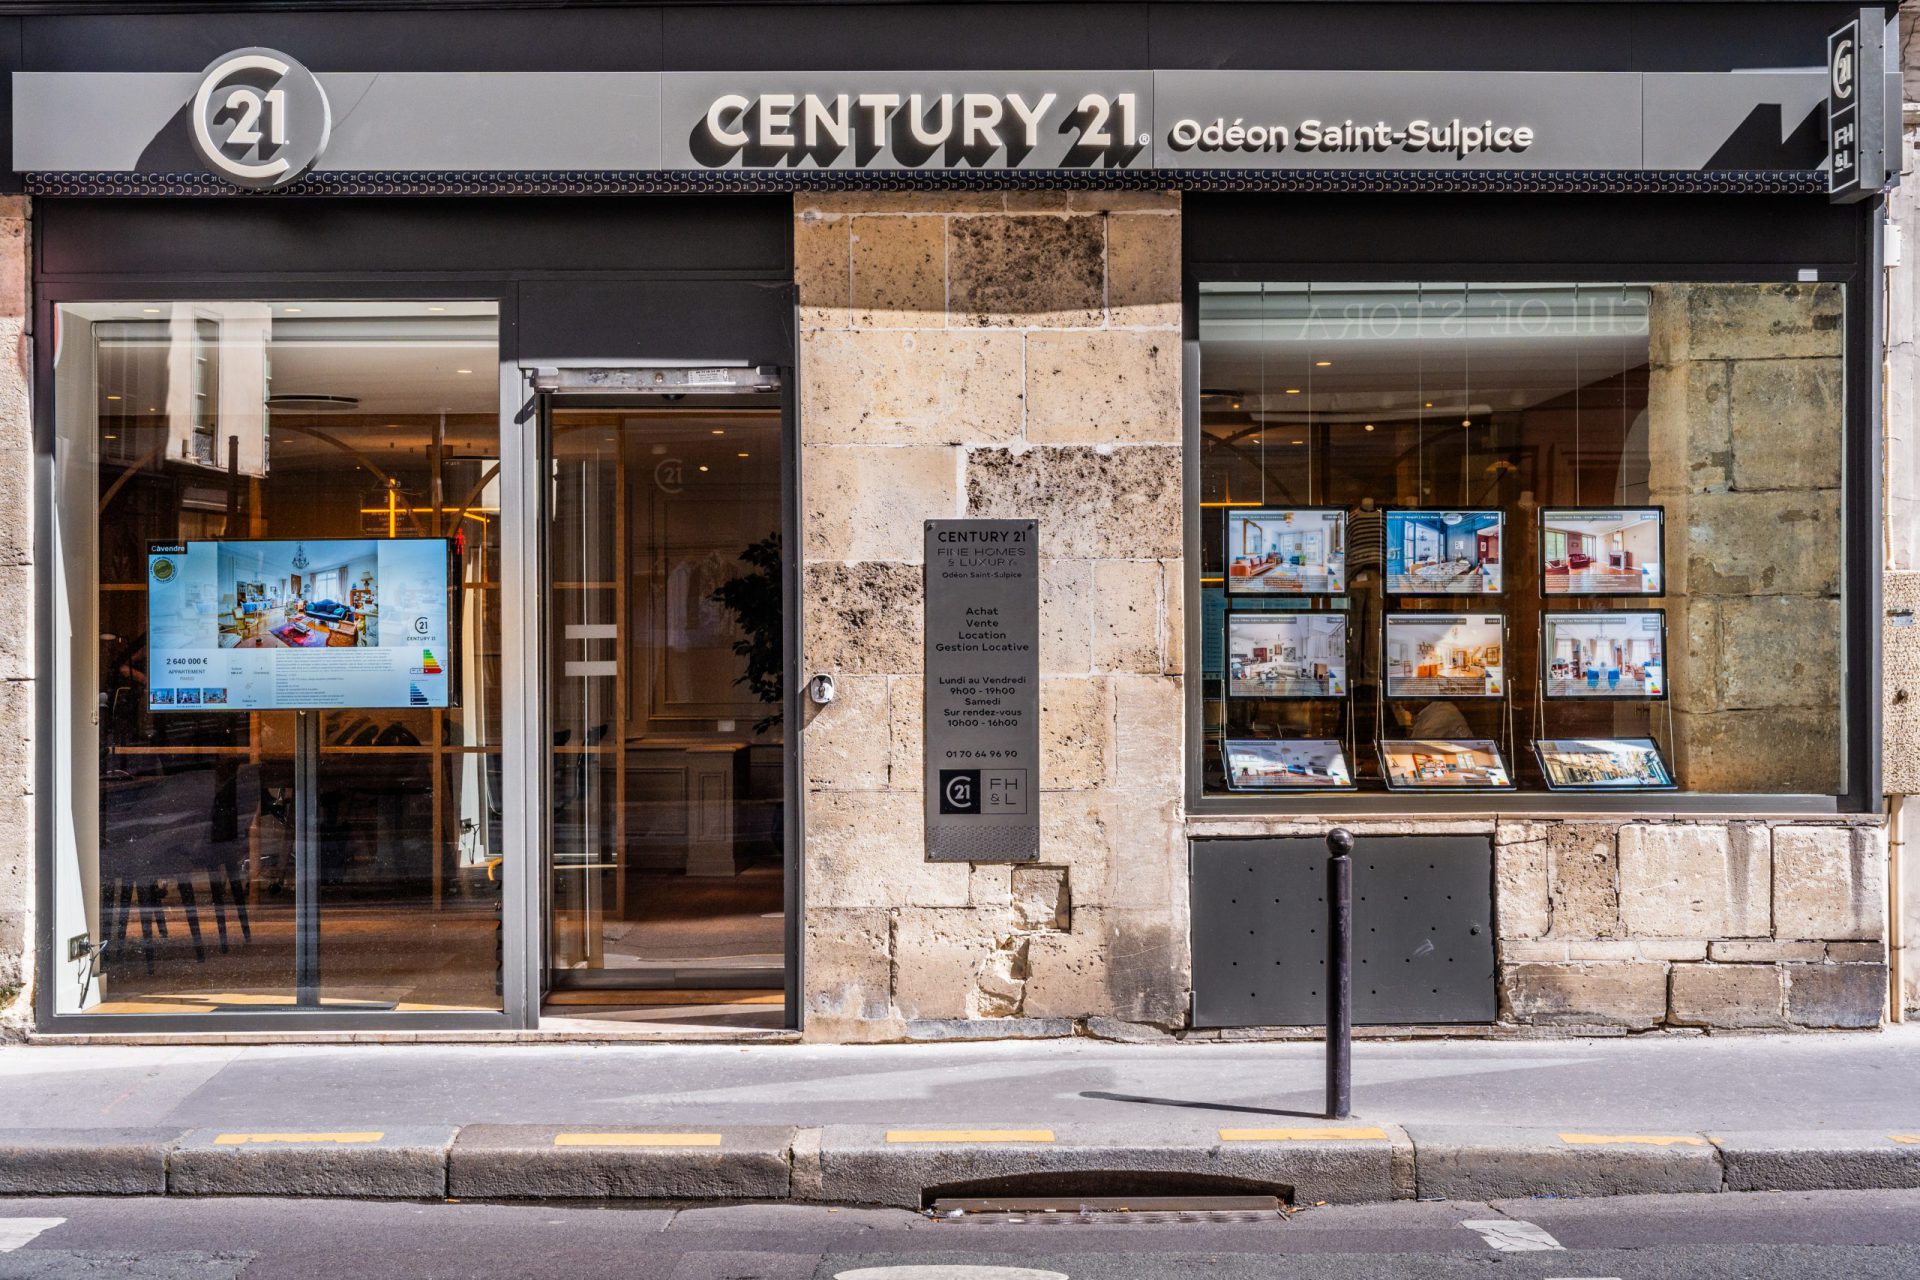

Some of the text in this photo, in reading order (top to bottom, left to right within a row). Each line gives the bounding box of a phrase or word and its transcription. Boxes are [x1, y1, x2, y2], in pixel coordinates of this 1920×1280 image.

[706, 93, 1056, 146] CENTURY
[1172, 118, 1534, 154] Odéon Saint-Sulpice
[938, 531, 1026, 542] CENTURY 21
[938, 548, 1026, 556] FINE HOMES
[970, 572, 1022, 580] Saint-Sulpice
[966, 607, 998, 616] Achat
[966, 620, 998, 628] Vente
[958, 631, 1006, 640] Location
[936, 643, 1029, 652] Gestion Locative
[939, 676, 966, 684] Lundi
[982, 676, 1026, 684] Vendredi
[950, 687, 976, 695] 9h00
[985, 687, 1015, 695] 19h00
